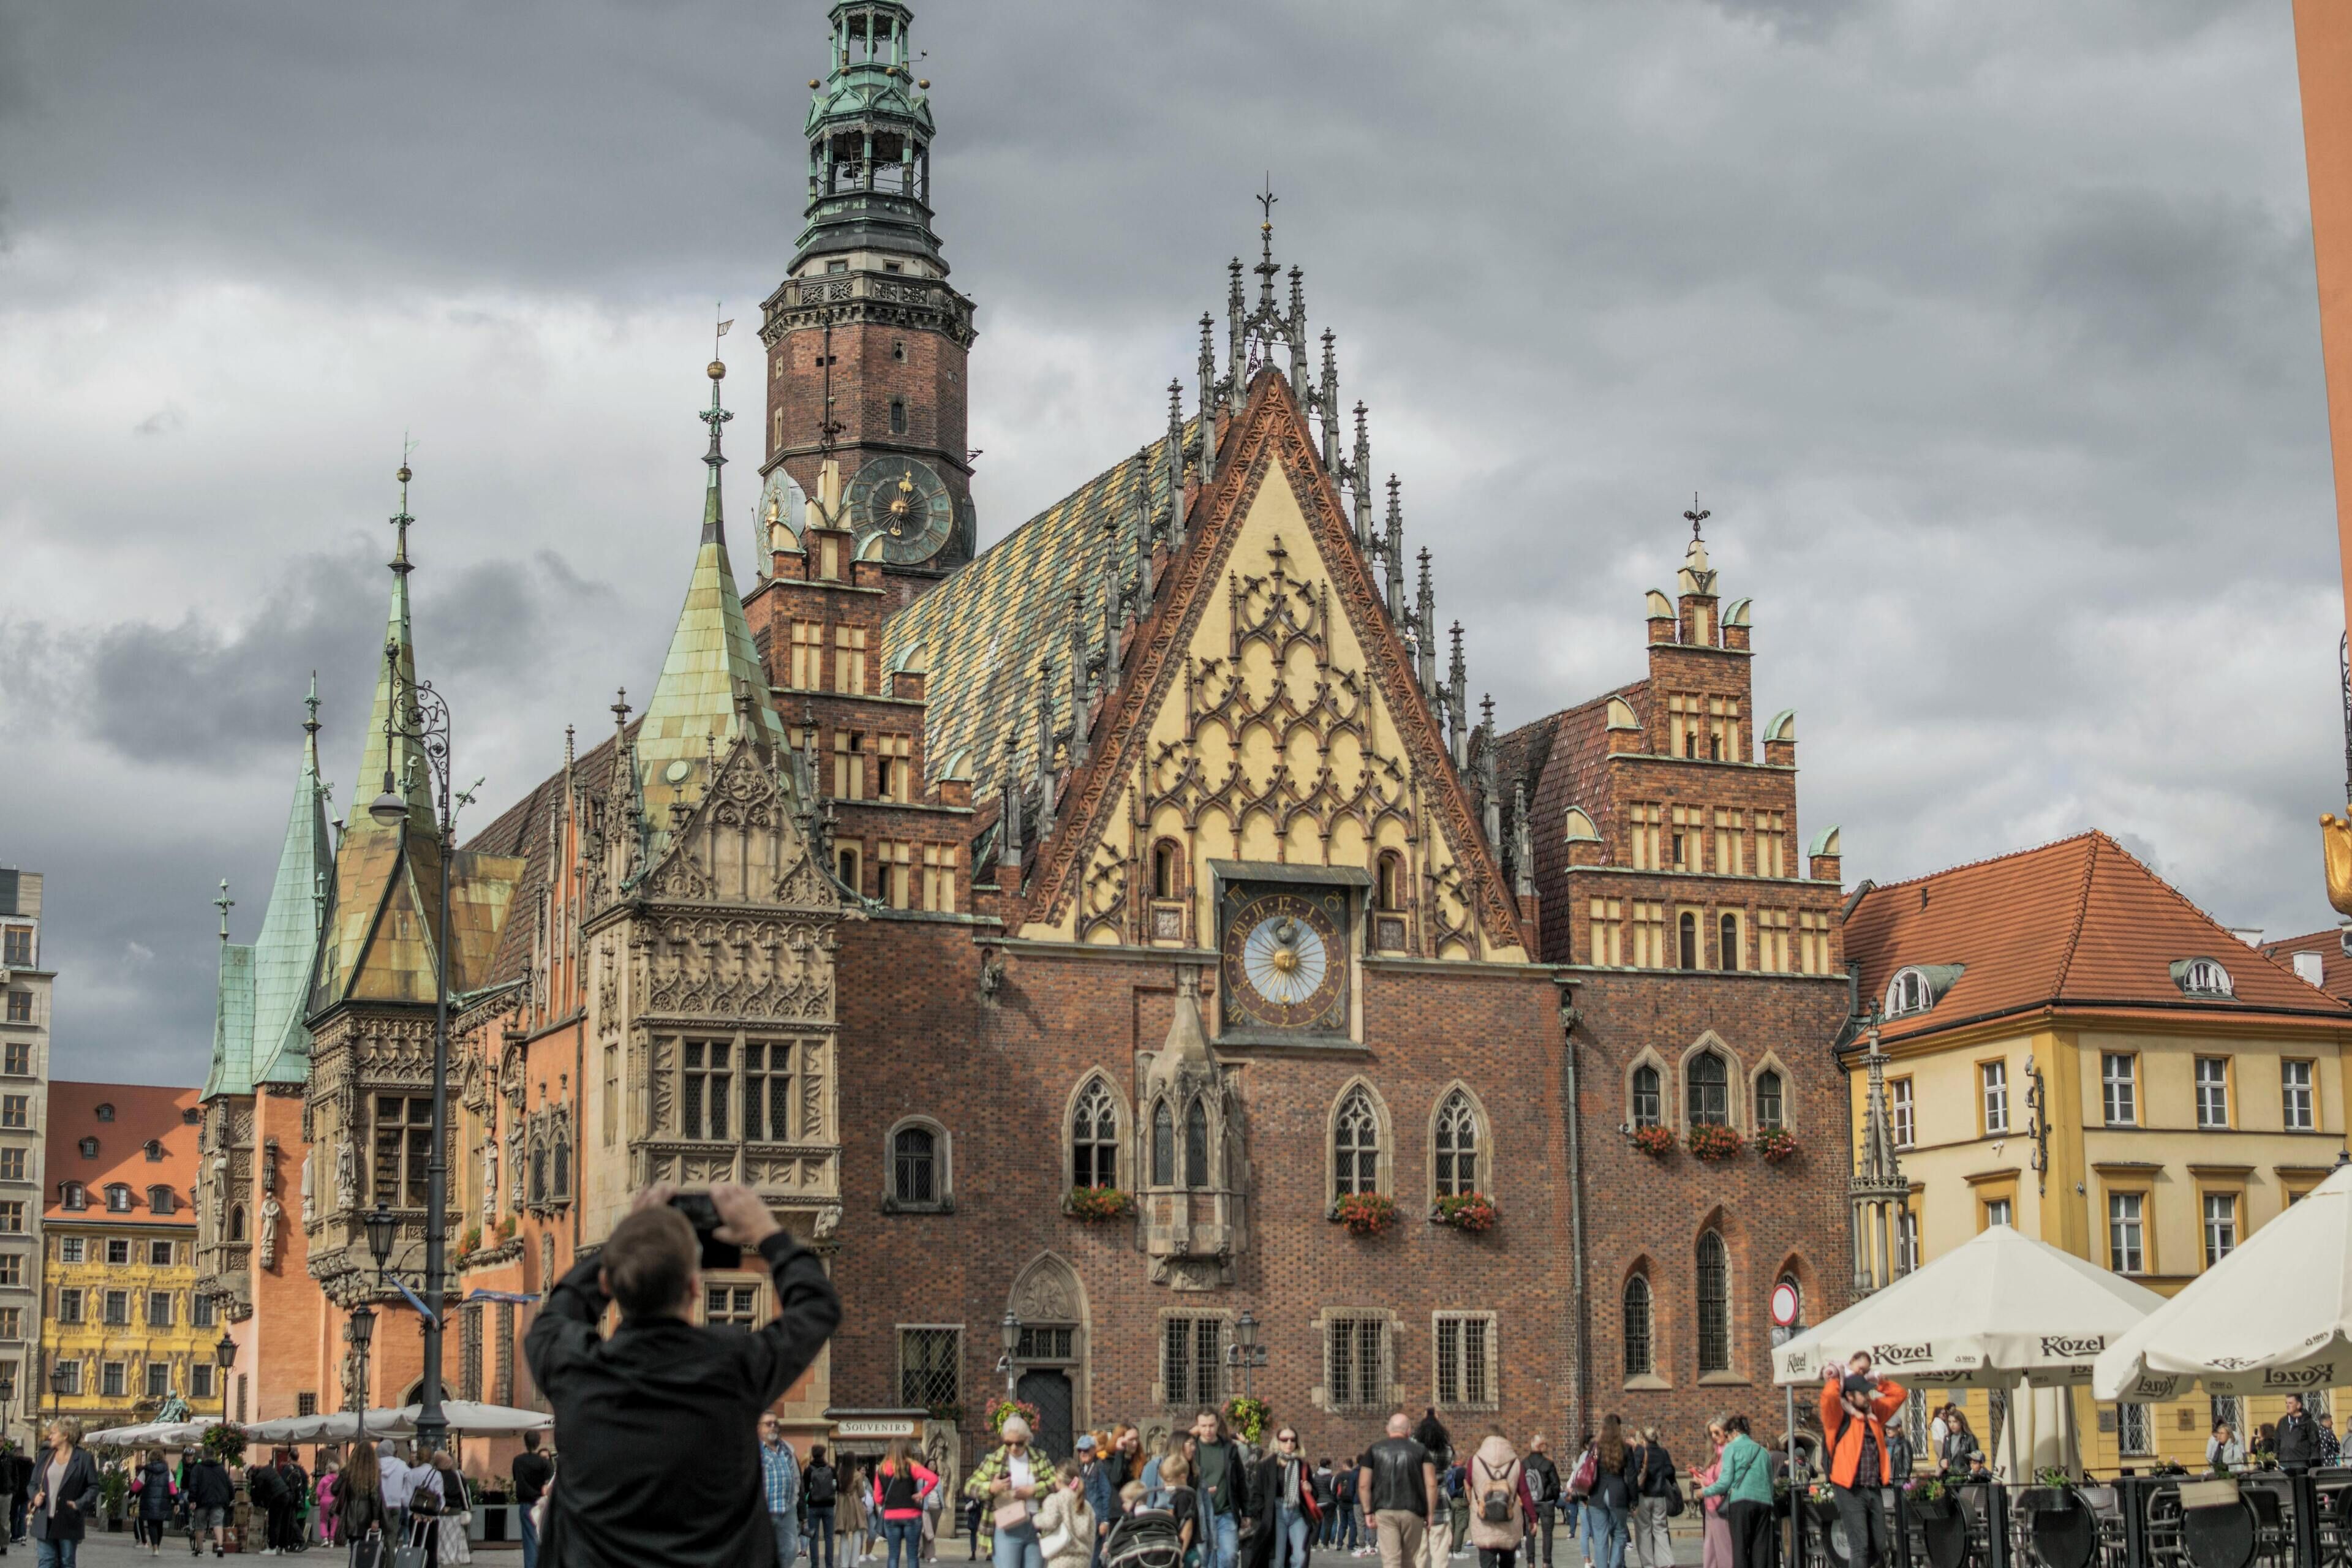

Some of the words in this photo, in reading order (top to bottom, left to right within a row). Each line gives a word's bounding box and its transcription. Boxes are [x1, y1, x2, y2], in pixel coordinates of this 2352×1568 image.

[1252, 902, 1265, 918] 11
[1278, 897, 1292, 911] 12
[1308, 906, 1315, 918] 1
[1232, 921, 1247, 938] 10
[1225, 953, 1239, 962] 9
[1233, 982, 1246, 992] 8
[2040, 1335, 2106, 1357] Kozel
[1872, 1343, 1934, 1365] Kozel
[1787, 1352, 1806, 1373] Kozel
[845, 1422, 907, 1431] SOUVENIRS
